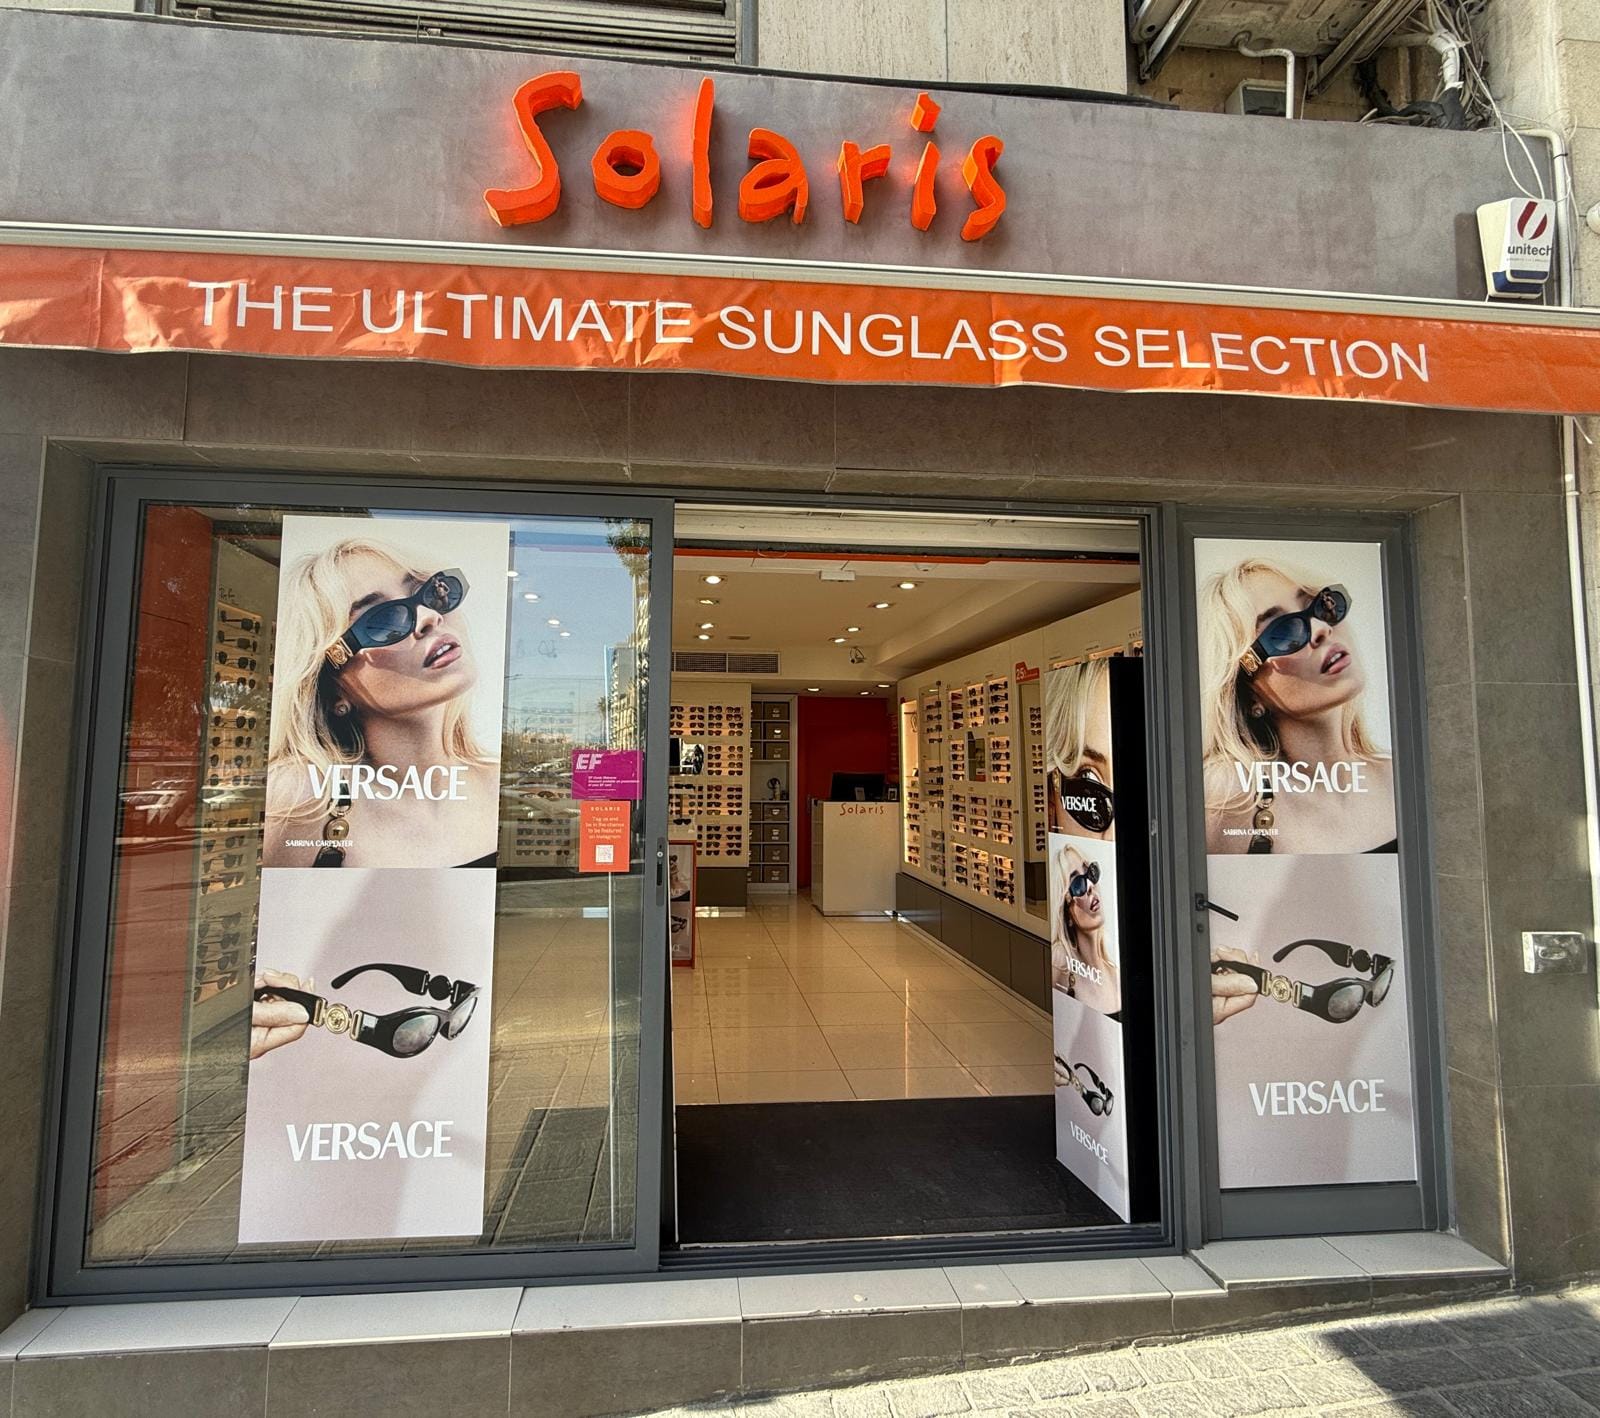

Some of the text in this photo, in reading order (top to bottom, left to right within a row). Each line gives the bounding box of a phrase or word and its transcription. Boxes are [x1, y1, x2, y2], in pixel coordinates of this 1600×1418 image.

[484, 70, 1007, 242] Solaris
[1507, 243, 1553, 256] unitech
[188, 280, 1429, 384] THE ULTIMATE SUNGLASS SELECTION
[575, 753, 603, 770] EF
[1234, 761, 1369, 793] VERSACE
[307, 764, 469, 801] VERSACE
[839, 802, 884, 816] Solaris
[1061, 795, 1098, 813] VERSACE
[285, 839, 353, 847] SABRINA CARPENTER
[1065, 955, 1103, 986] VERSACE
[1249, 1079, 1387, 1116] VERSACE
[286, 1120, 454, 1162] VERSACE
[1070, 1121, 1109, 1166] VERSACE
